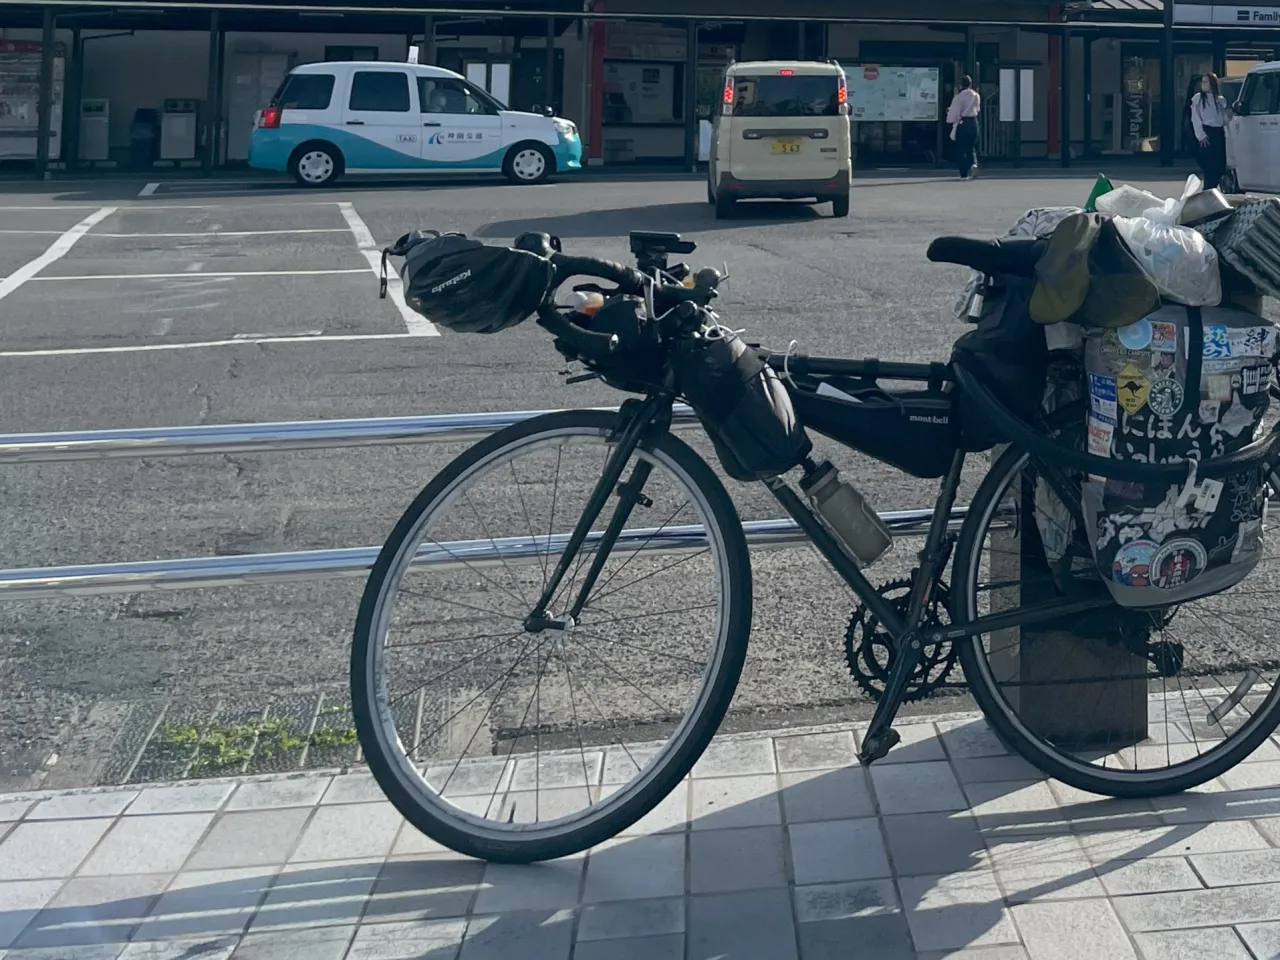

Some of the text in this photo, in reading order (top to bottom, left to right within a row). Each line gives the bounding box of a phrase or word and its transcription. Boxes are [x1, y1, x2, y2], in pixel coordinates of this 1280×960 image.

[399, 135, 416, 143] TAXI
[1122, 413, 1202, 439] にほん
